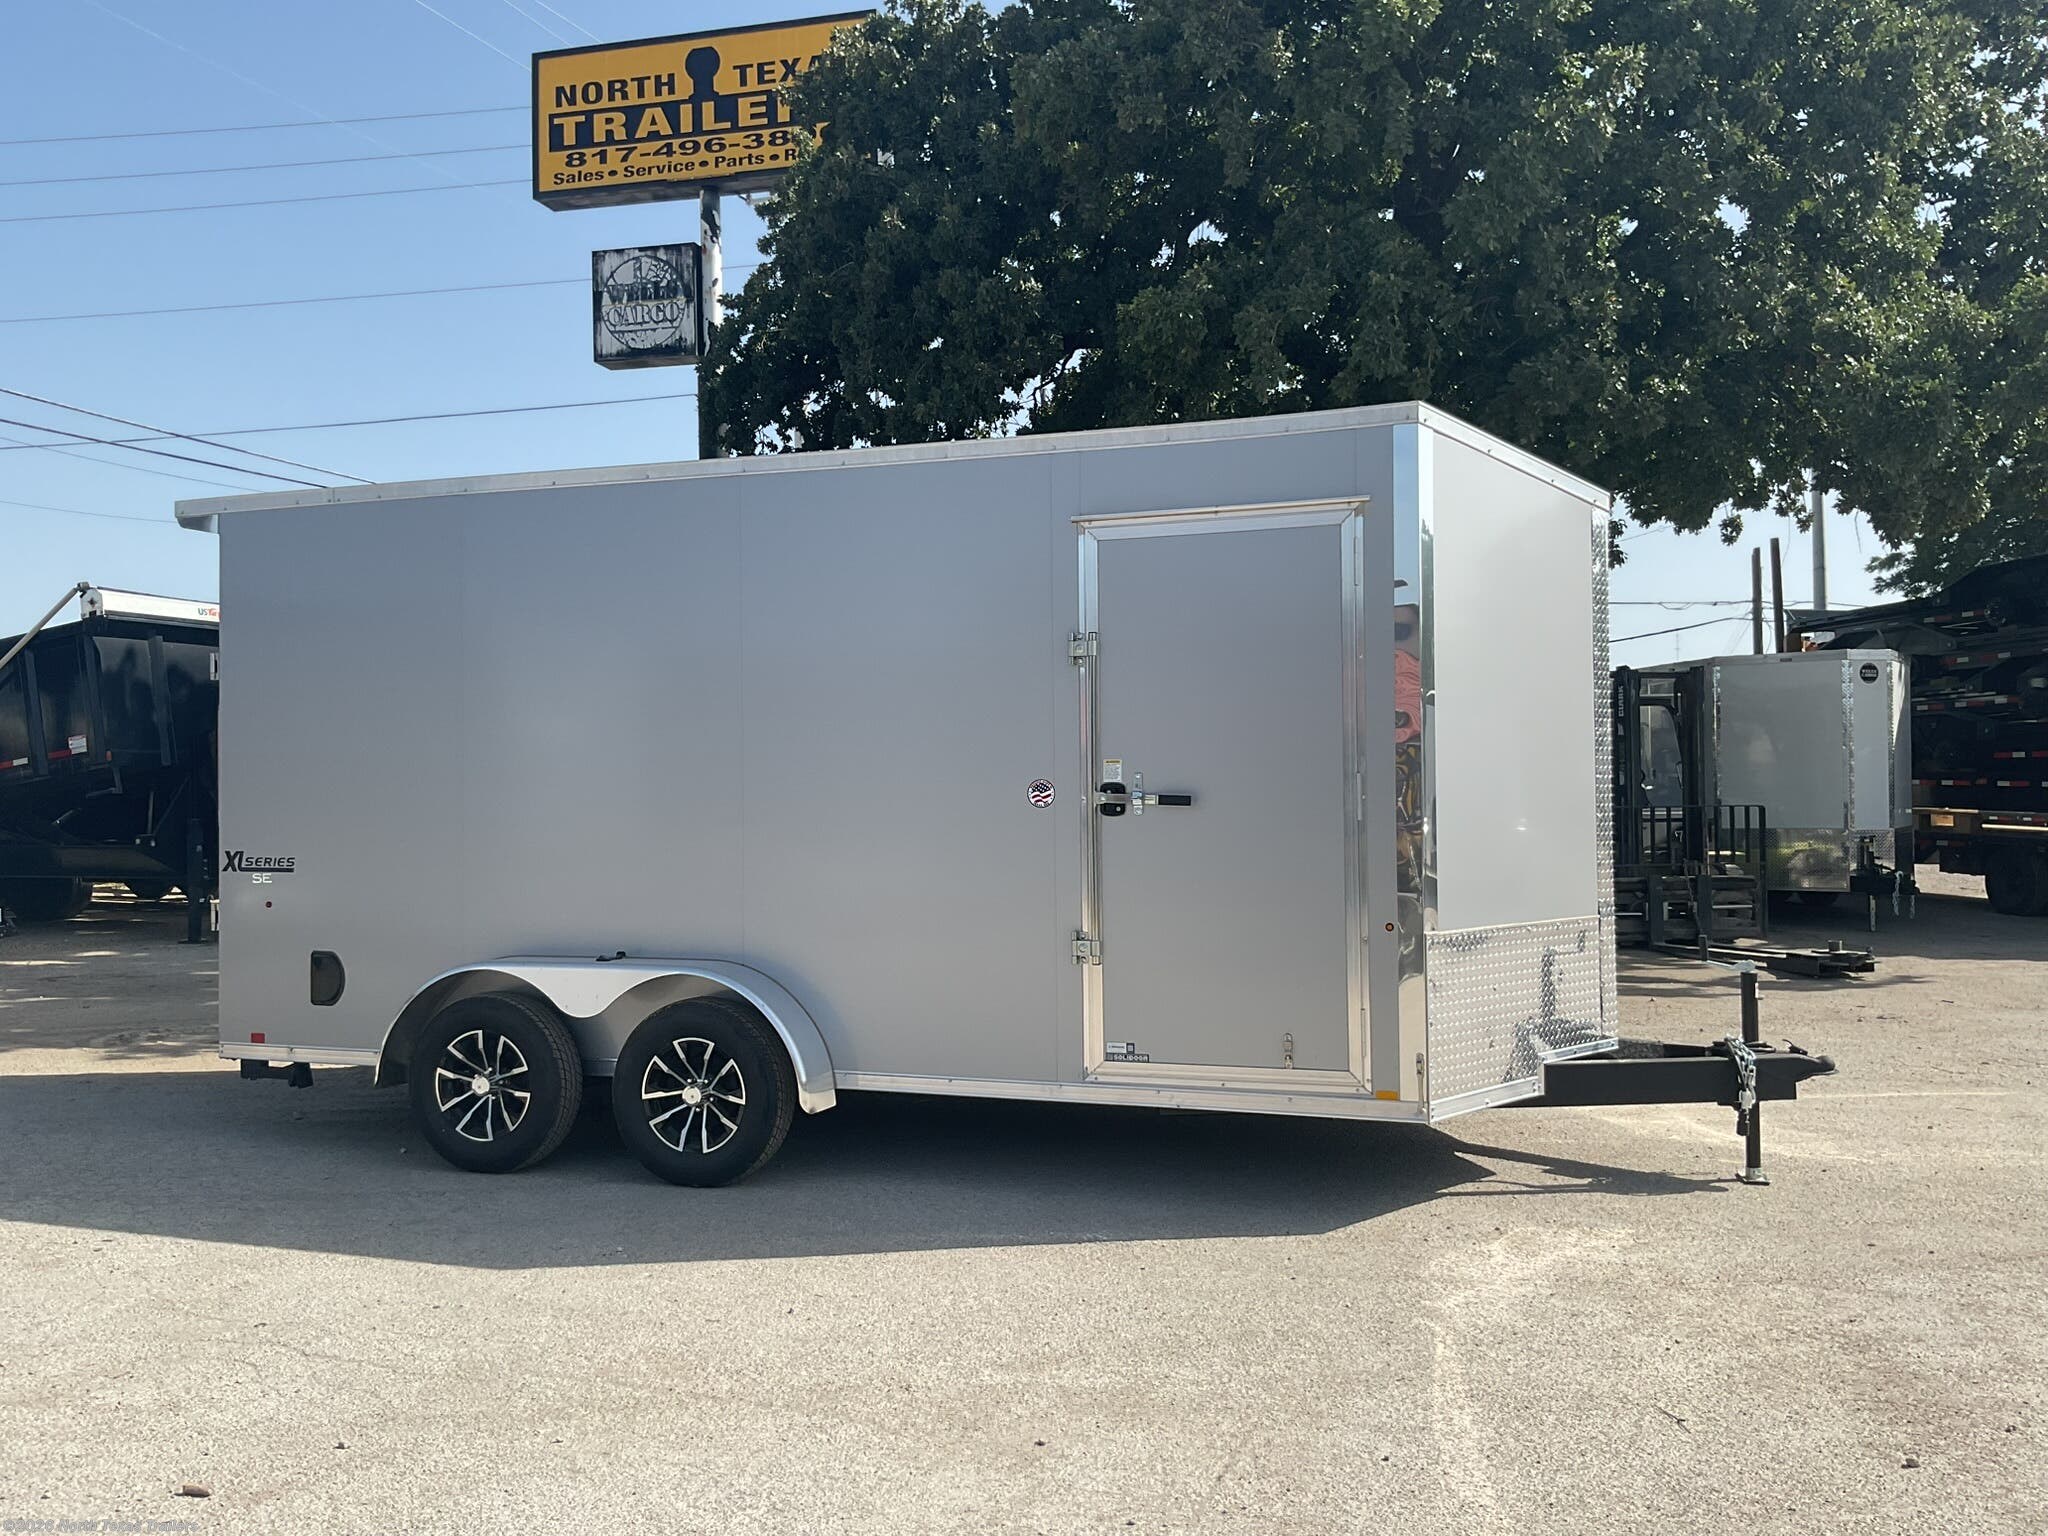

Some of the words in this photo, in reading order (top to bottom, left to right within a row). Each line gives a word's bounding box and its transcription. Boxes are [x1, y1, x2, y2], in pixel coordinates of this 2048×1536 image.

[555, 73, 676, 108] NORTH
[565, 130, 791, 168] 817-496-38
[553, 170, 604, 186] Sales
[623, 161, 695, 179] Service
[714, 153, 765, 169] Parts
[608, 301, 680, 326] CARGO
[244, 857, 295, 867] SERIES
[252, 873, 272, 884] SE
